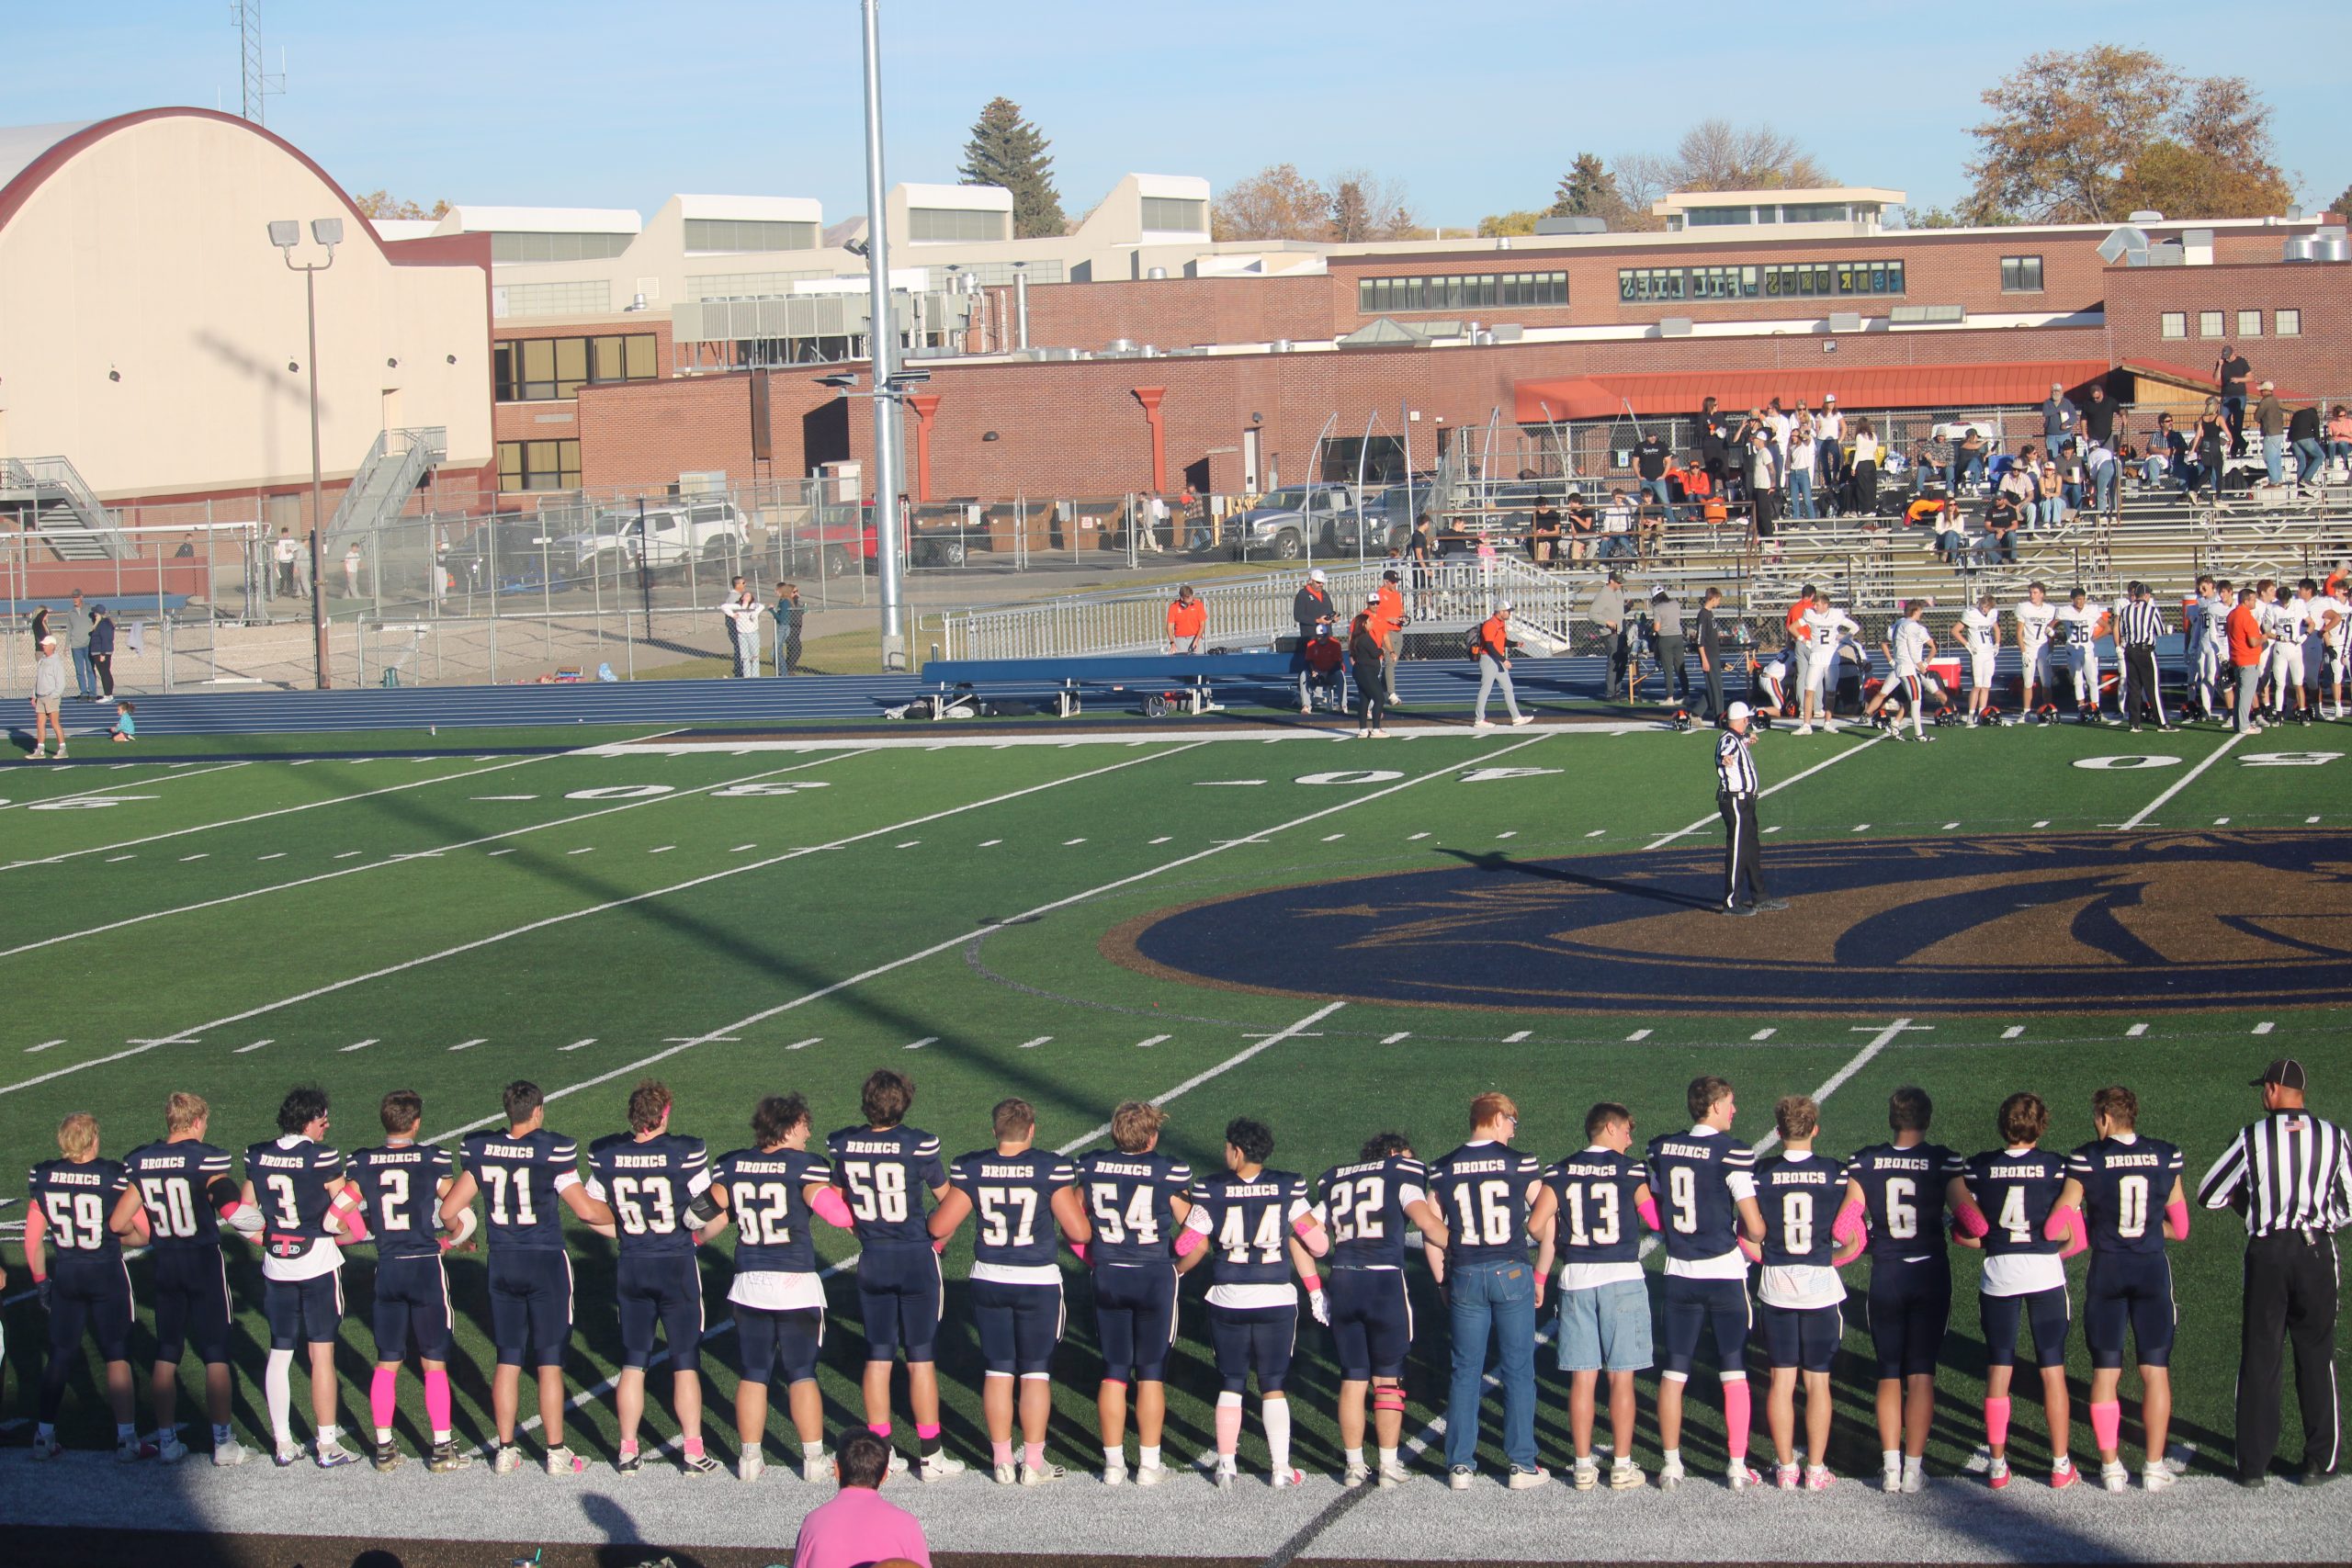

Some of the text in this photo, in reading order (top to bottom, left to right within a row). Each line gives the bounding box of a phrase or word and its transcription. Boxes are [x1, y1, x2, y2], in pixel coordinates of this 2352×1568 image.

[1819, 629, 1831, 645] 2
[2033, 623, 2042, 639] 7
[2070, 625, 2089, 644] 36
[2282, 624, 2293, 640] 9
[483, 1143, 535, 1159] BRONCS
[845, 1140, 901, 1155] BRONCS
[1660, 1142, 1712, 1160] BRONCS
[140, 1156, 186, 1170] BRONCS
[258, 1153, 304, 1169] BRONCS
[368, 1152, 422, 1166] BRONCS
[614, 1154, 668, 1168] BRONCS
[734, 1160, 786, 1174] BRONCS
[1453, 1158, 1507, 1176] BRONCS
[1873, 1156, 1928, 1170] BRONCS
[2104, 1153, 2159, 1169] BRONCS
[980, 1164, 1035, 1179] BRONCS
[1093, 1160, 1152, 1177] BRONCS
[1335, 1159, 1385, 1179] BRONCS
[1566, 1161, 1618, 1178] BRONCS
[1771, 1170, 1827, 1185] BRONCS
[1989, 1164, 2045, 1179] BRONCS
[49, 1171, 101, 1186] BRONCS
[379, 1168, 411, 1231] 2
[481, 1165, 537, 1225] 71
[843, 1160, 908, 1224] 58
[1225, 1183, 1280, 1198] BRONCS
[139, 1177, 198, 1237] 50
[266, 1173, 301, 1230] 3
[612, 1176, 675, 1235] 63
[1669, 1166, 1698, 1235] 9
[1885, 1177, 1917, 1239] 6
[2118, 1175, 2149, 1238] 0
[731, 1181, 791, 1246] 62
[977, 1186, 1038, 1247] 57
[1091, 1182, 1159, 1245] 54
[1329, 1176, 1385, 1245] 22
[1453, 1179, 1511, 1246] 16
[1566, 1181, 1621, 1247] 13
[1998, 1185, 2032, 1243] 4
[44, 1191, 104, 1250] 59
[1781, 1191, 1815, 1256] 8
[1218, 1203, 1283, 1265] 44
